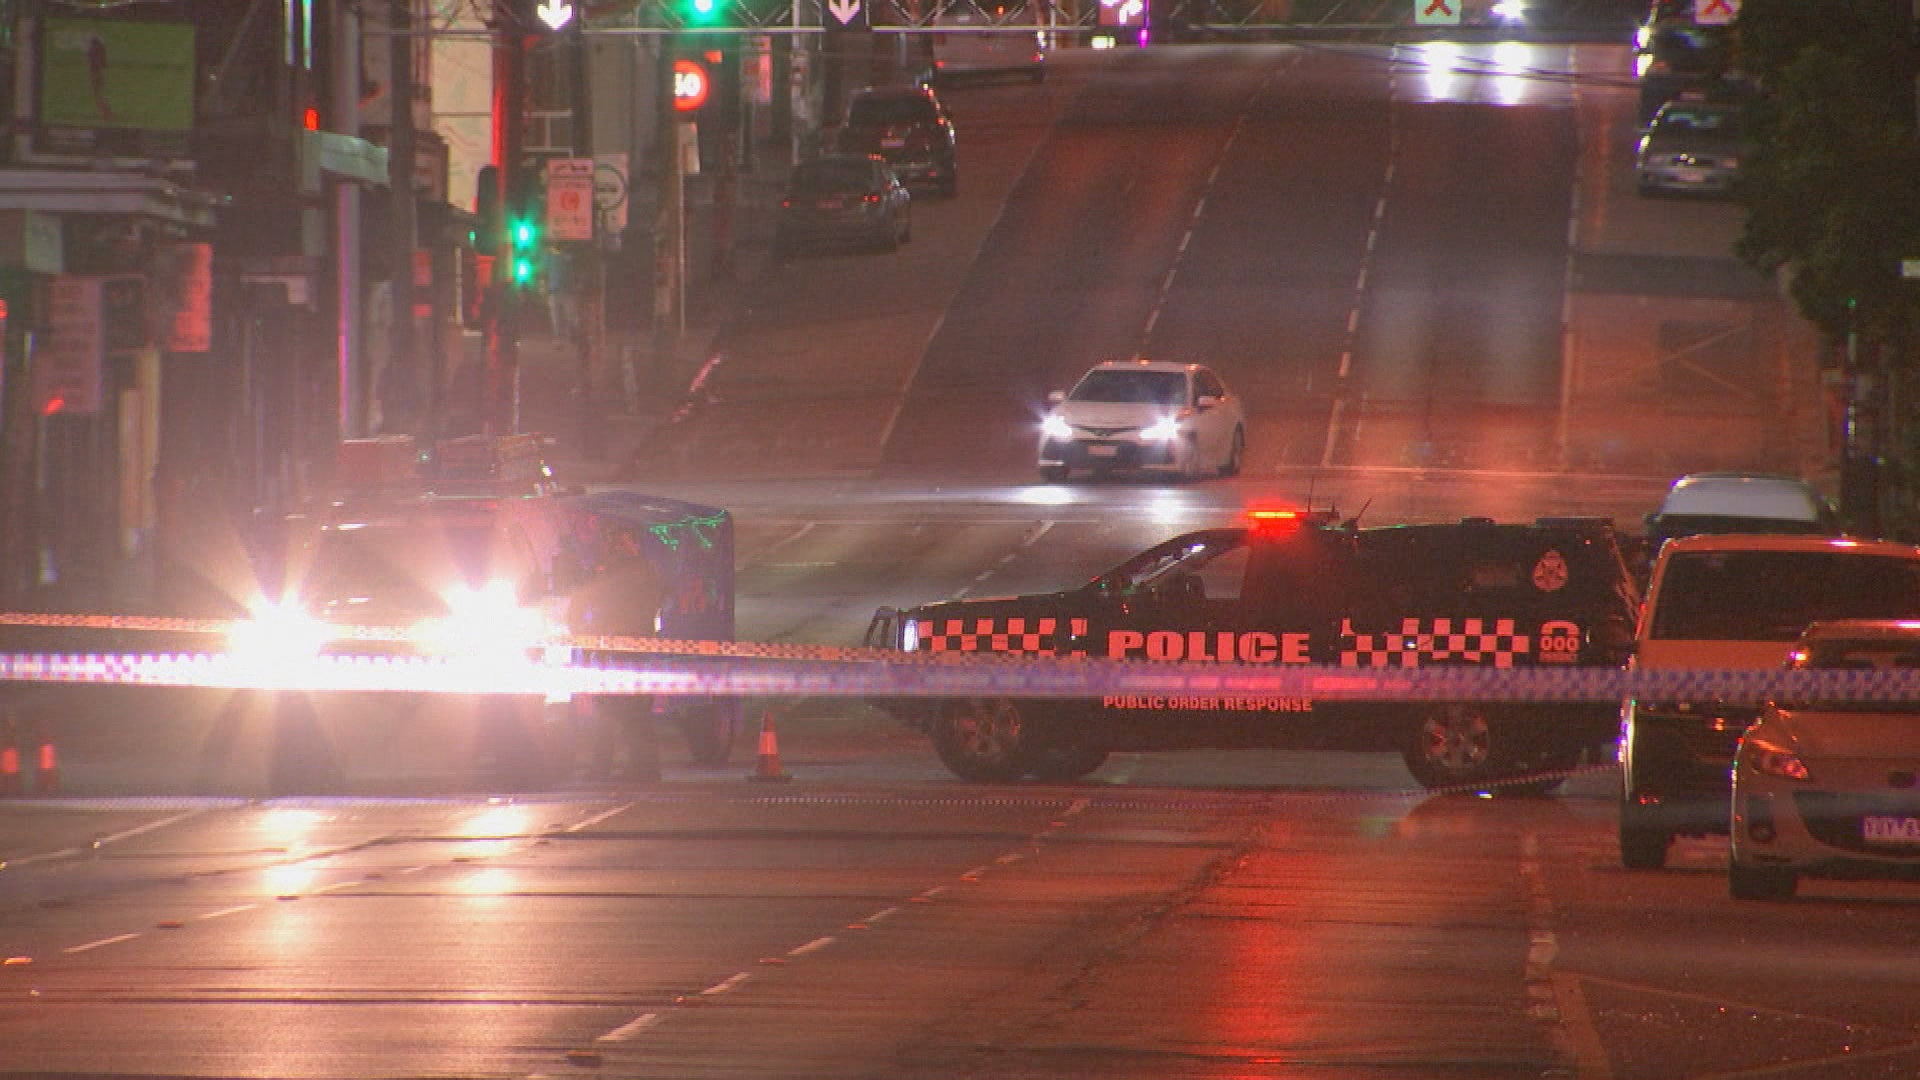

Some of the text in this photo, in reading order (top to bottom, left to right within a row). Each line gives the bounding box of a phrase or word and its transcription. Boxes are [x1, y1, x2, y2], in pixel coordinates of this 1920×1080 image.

[1108, 630, 1311, 662] POLICE
[1541, 636, 1579, 651] 000
[1103, 695, 1313, 712] PUBLIC ORDER RESPONSE
